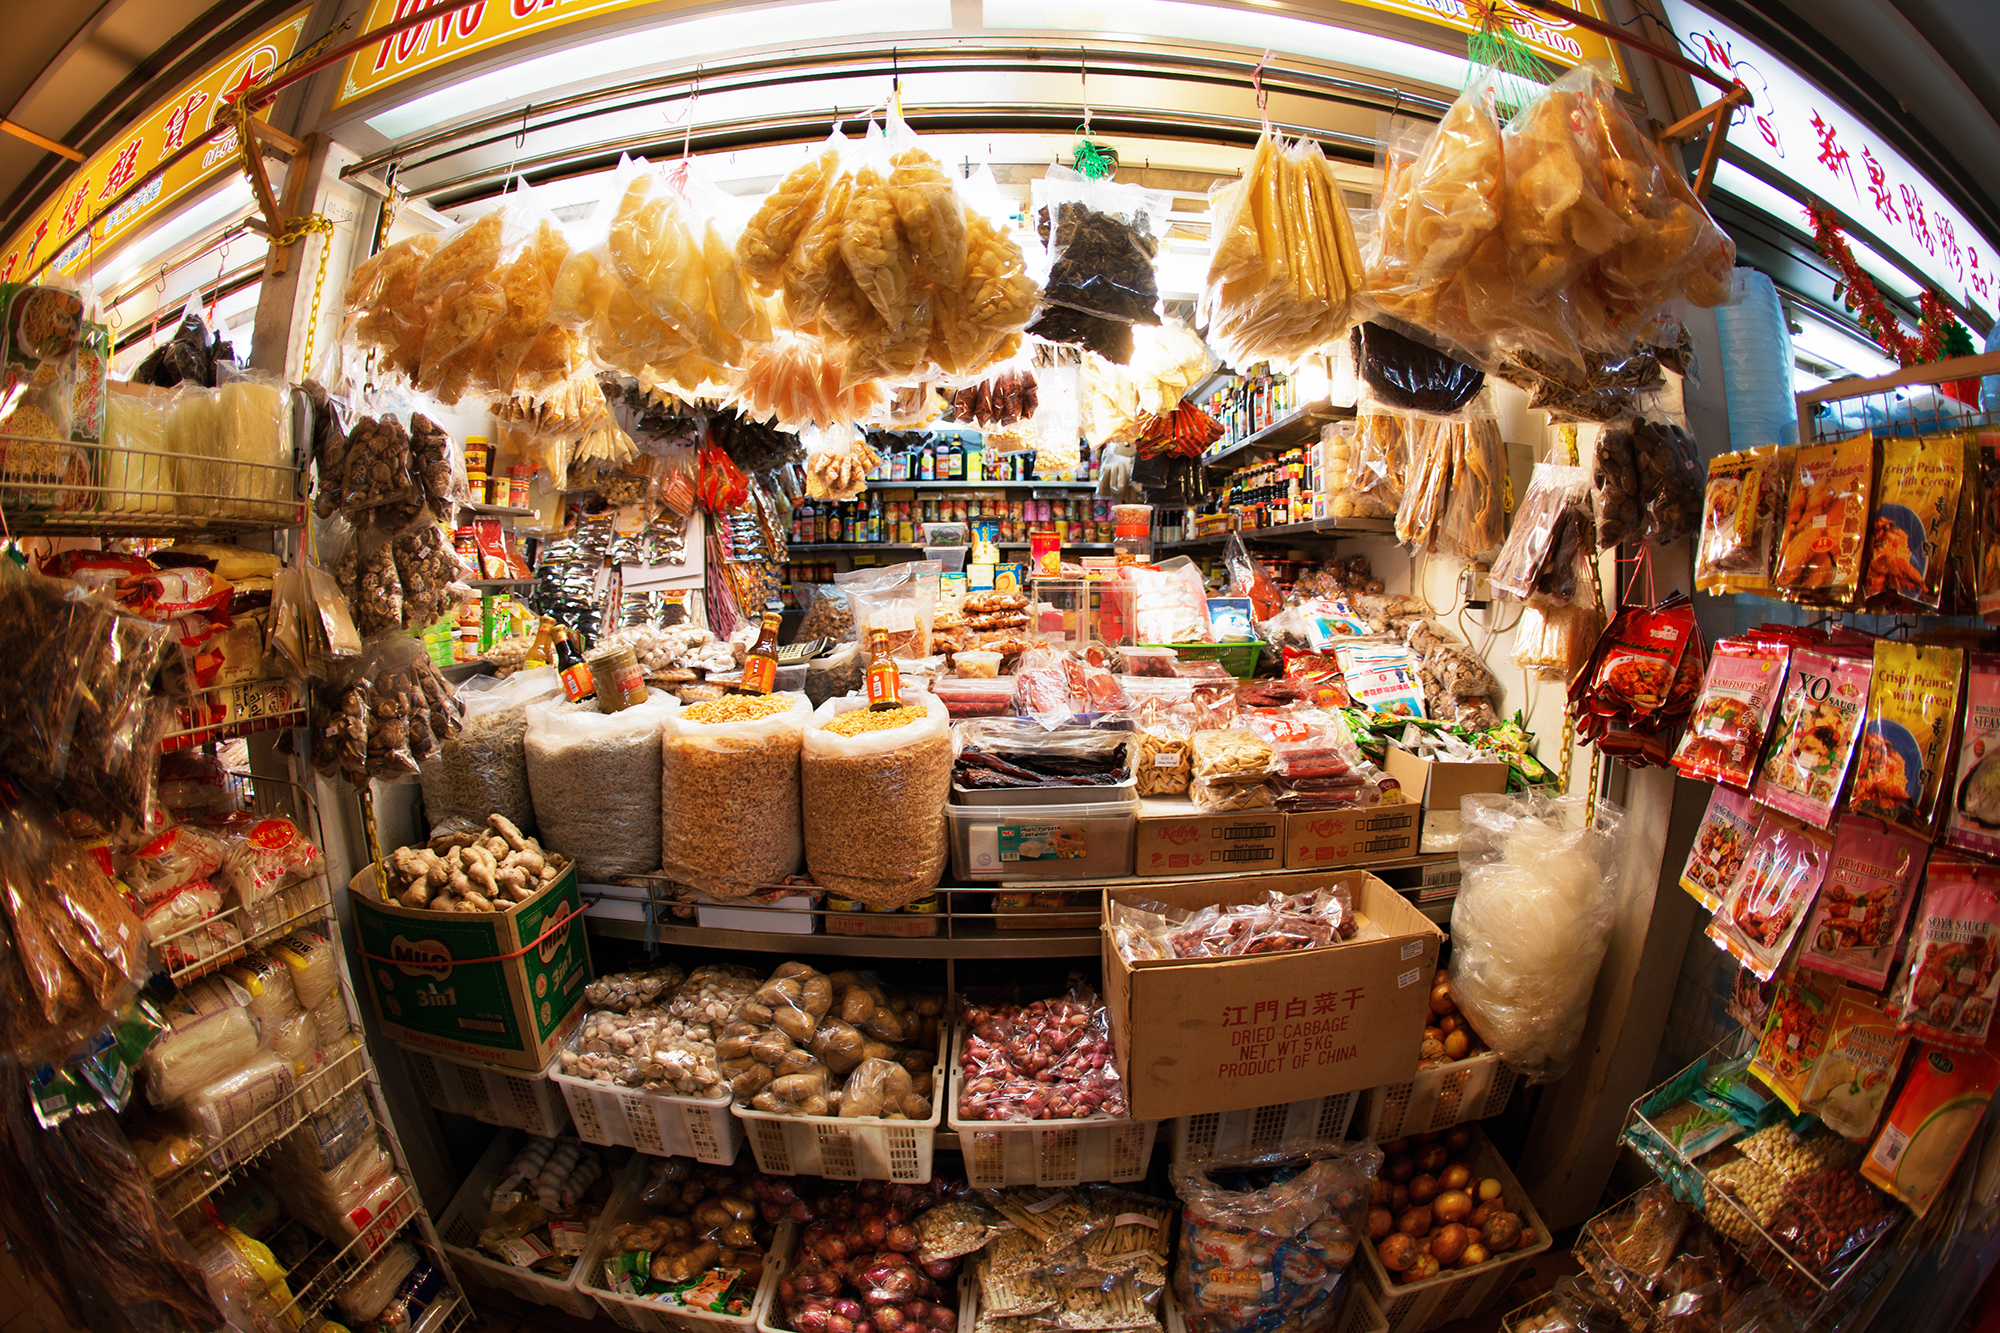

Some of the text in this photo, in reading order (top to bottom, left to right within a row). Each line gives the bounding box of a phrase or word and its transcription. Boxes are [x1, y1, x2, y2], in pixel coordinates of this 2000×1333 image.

[1826, 464, 1866, 479] Chicken
[1917, 461, 1956, 475] Prawns
[1897, 476, 1956, 490] with Cereal
[1794, 670, 1832, 703] XO
[1878, 669, 1954, 691] Crispy Prawns
[1828, 695, 1859, 712] SAUCE
[1892, 689, 1916, 702] with
[1157, 824, 1201, 846] Kelly's
[1305, 818, 1347, 839] Kelly's
[1833, 869, 1862, 887] SAUCE
[1837, 857, 1856, 871] DRY
[1855, 862, 1881, 878] FRIED
[1927, 916, 1990, 934] SOYA SAUCE
[1925, 929, 1975, 945] STEAM FISH
[394, 945, 449, 973] MILO
[1221, 986, 1366, 1028] 江門白菜干
[1231, 1015, 1350, 1047] DRIED CABBAGE
[1851, 1025, 1898, 1050] HAINANESE
[403, 1030, 506, 1060] Your Healthier Choice!
[1240, 1044, 1270, 1061] NET
[1218, 1045, 1358, 1078] PRODUCT OF CHINA
